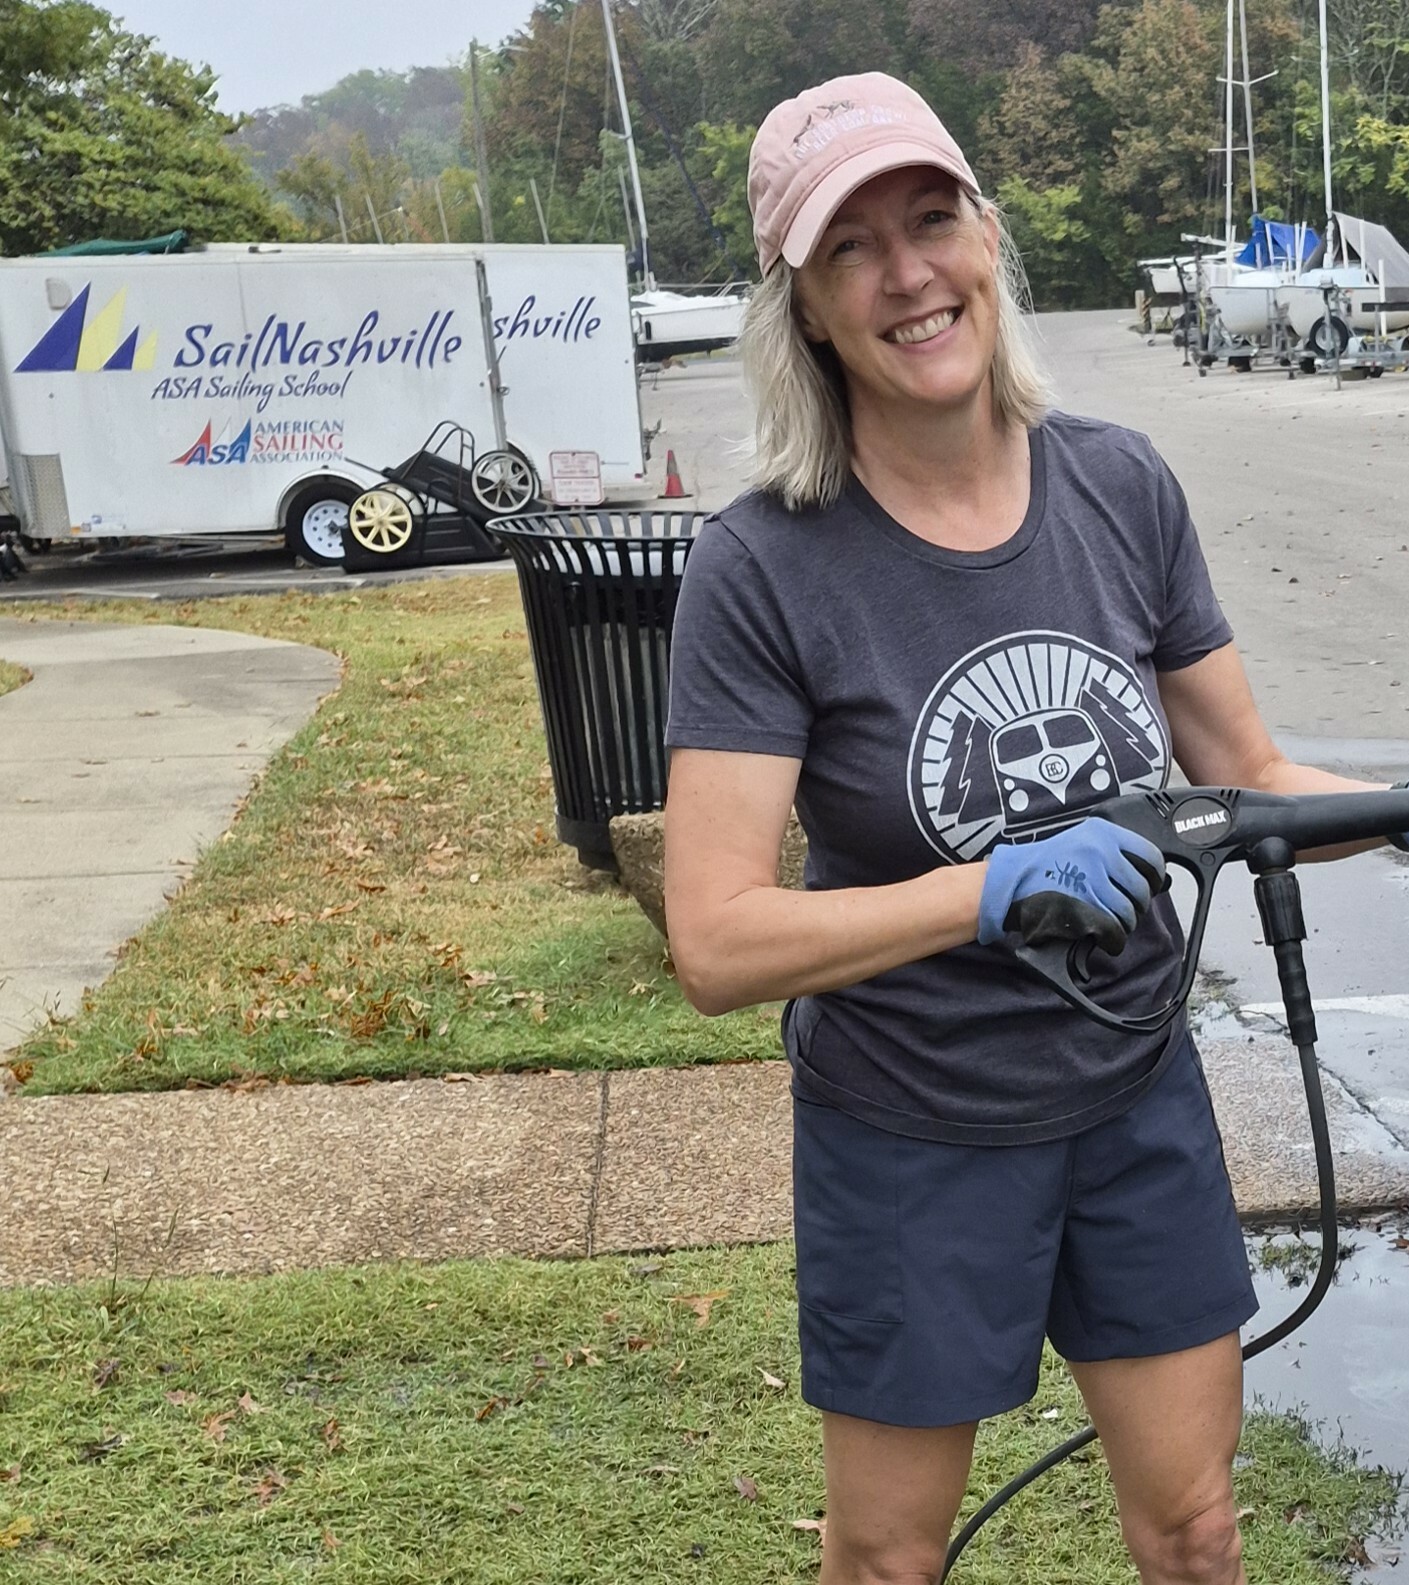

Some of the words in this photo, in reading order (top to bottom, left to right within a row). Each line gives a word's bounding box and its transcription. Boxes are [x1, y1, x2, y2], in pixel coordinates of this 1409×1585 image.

[173, 310, 462, 373] SailNashville
[150, 376, 203, 399] ASA
[204, 371, 275, 413] Sailing
[278, 370, 353, 399] School
[254, 420, 344, 434] AMERICAN
[253, 433, 344, 452] SAILING
[185, 443, 247, 466] ASA
[250, 451, 344, 465] ASSOCIATION
[1174, 814, 1207, 834] BLACK
[1204, 809, 1228, 826] MAX
